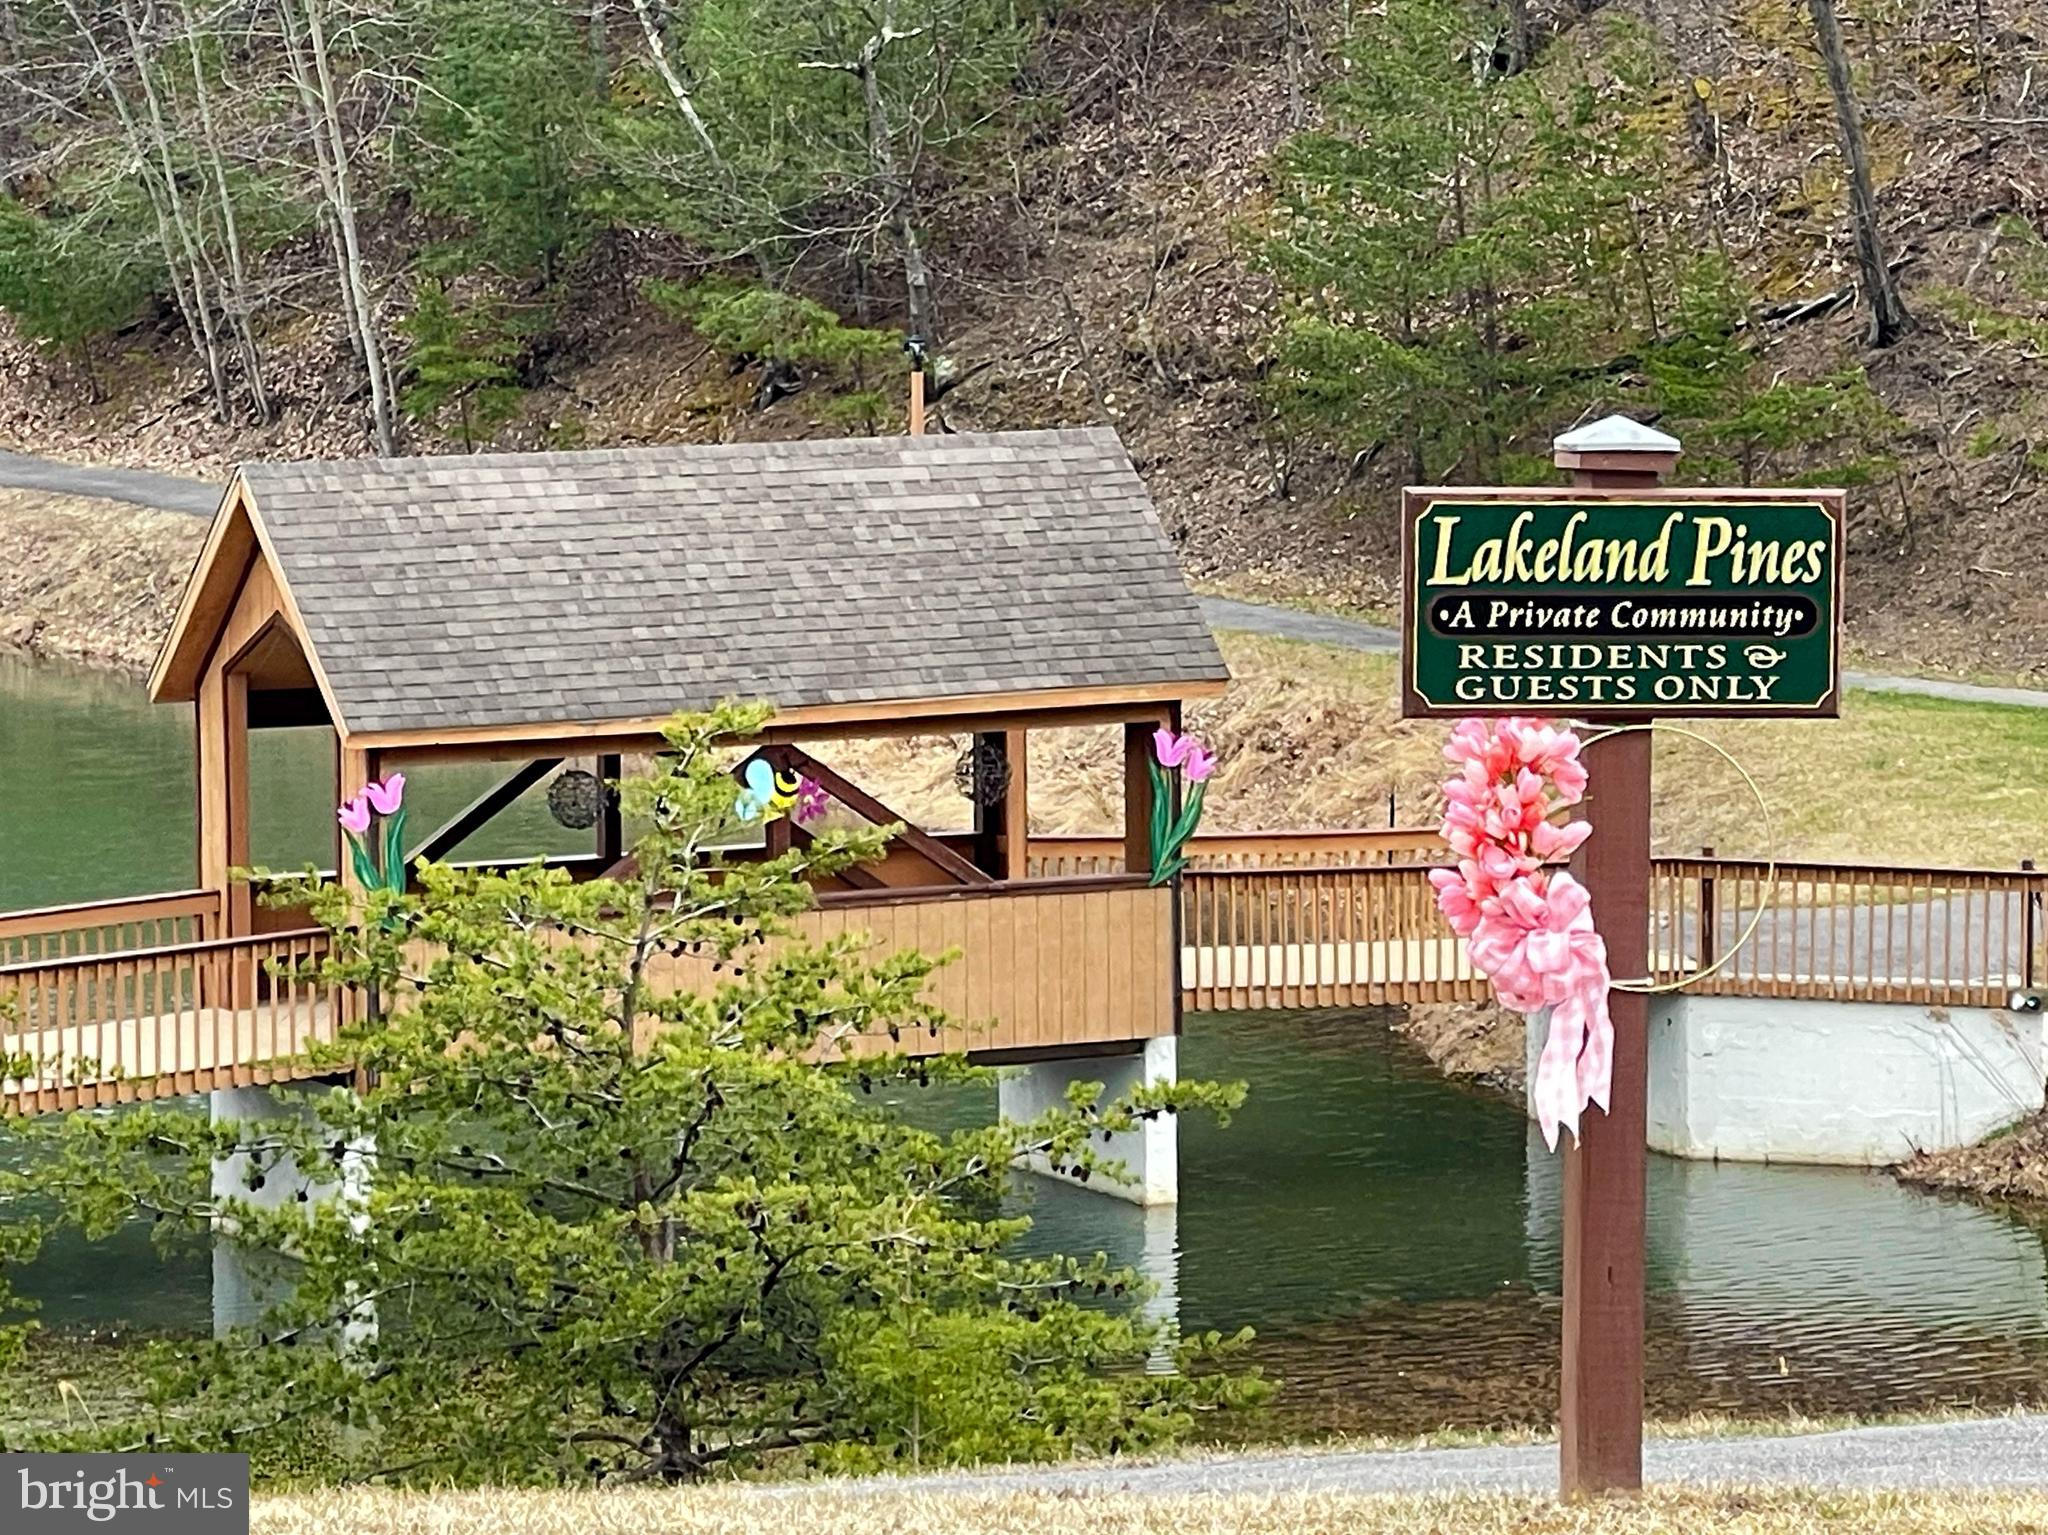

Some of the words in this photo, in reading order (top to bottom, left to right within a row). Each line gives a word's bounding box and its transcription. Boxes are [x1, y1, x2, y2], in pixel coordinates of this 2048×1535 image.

[1425, 510, 1684, 586] Lakeland
[1685, 515, 1826, 587] Pines
[1486, 600, 1600, 629] Private
[1457, 643, 1728, 670] RESIDENTS
[1454, 674, 1637, 701] GUESTS
[1653, 674, 1781, 701] ONLY
